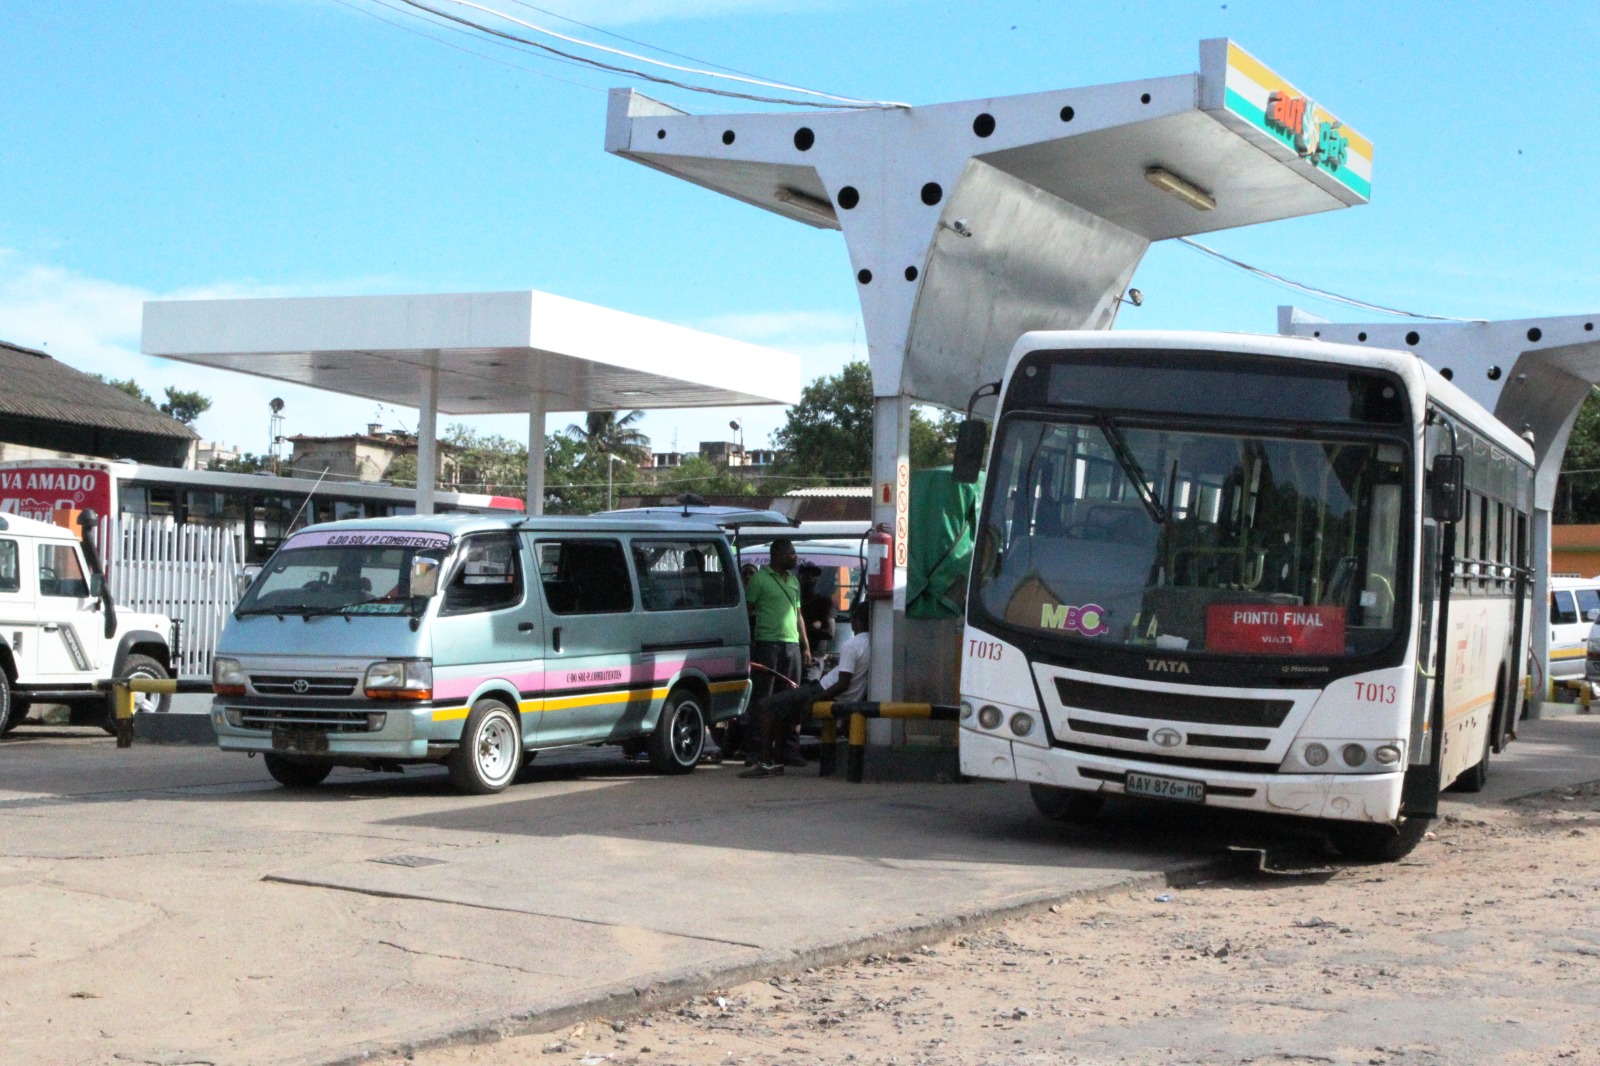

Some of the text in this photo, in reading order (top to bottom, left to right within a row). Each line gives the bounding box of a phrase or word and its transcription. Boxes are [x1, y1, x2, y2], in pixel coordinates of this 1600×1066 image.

[26, 473, 96, 492] AMADO
[1233, 611, 1323, 627] PONTO FINAL
[969, 639, 1003, 661] T013
[1146, 658, 1190, 674] TATA
[1354, 681, 1396, 704] T013
[1128, 775, 1202, 798] AAY 876 MC
